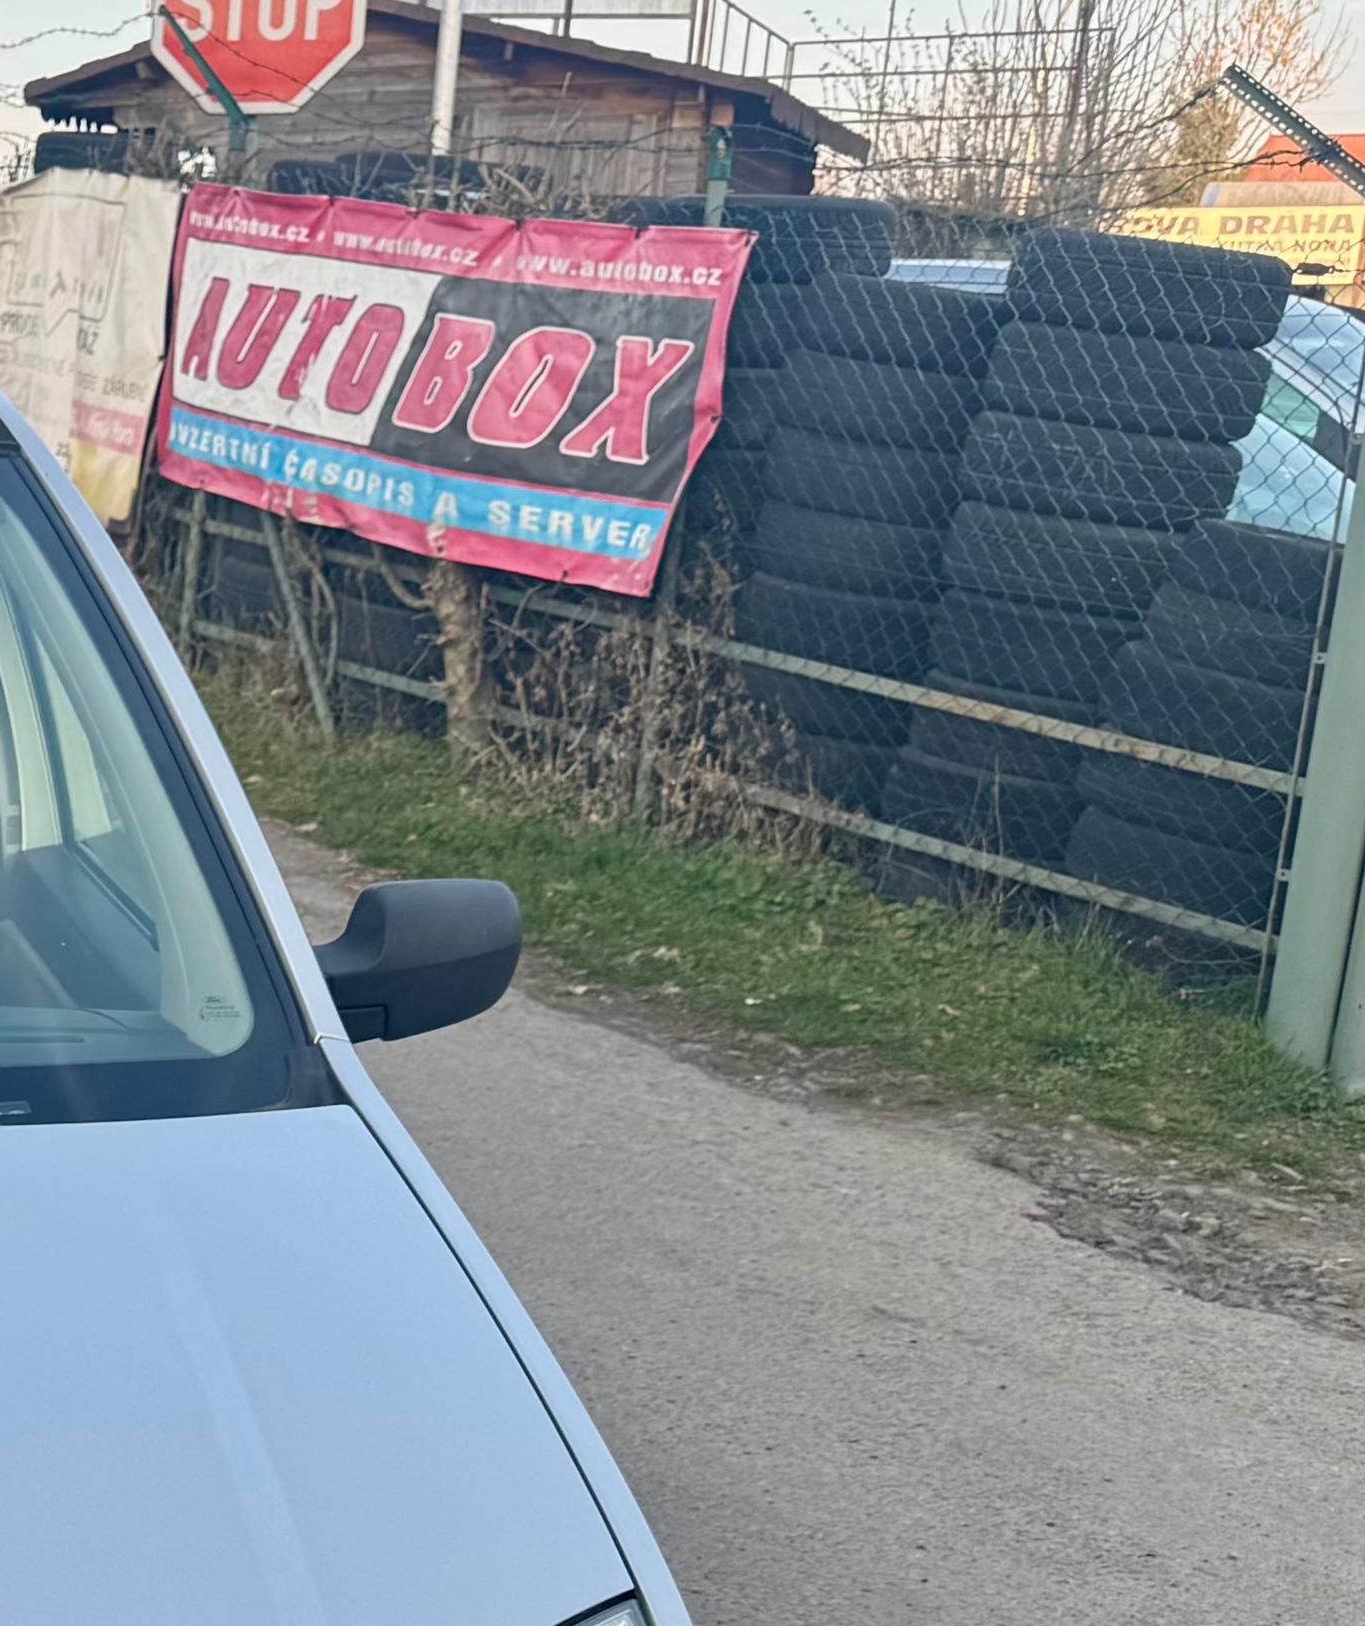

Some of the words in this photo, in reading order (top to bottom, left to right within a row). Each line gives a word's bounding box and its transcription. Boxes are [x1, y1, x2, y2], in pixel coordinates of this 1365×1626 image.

[181, 276, 695, 465] AUTOBOX
[283, 448, 415, 508] ČASOPIS
[488, 499, 652, 551] SERVER
